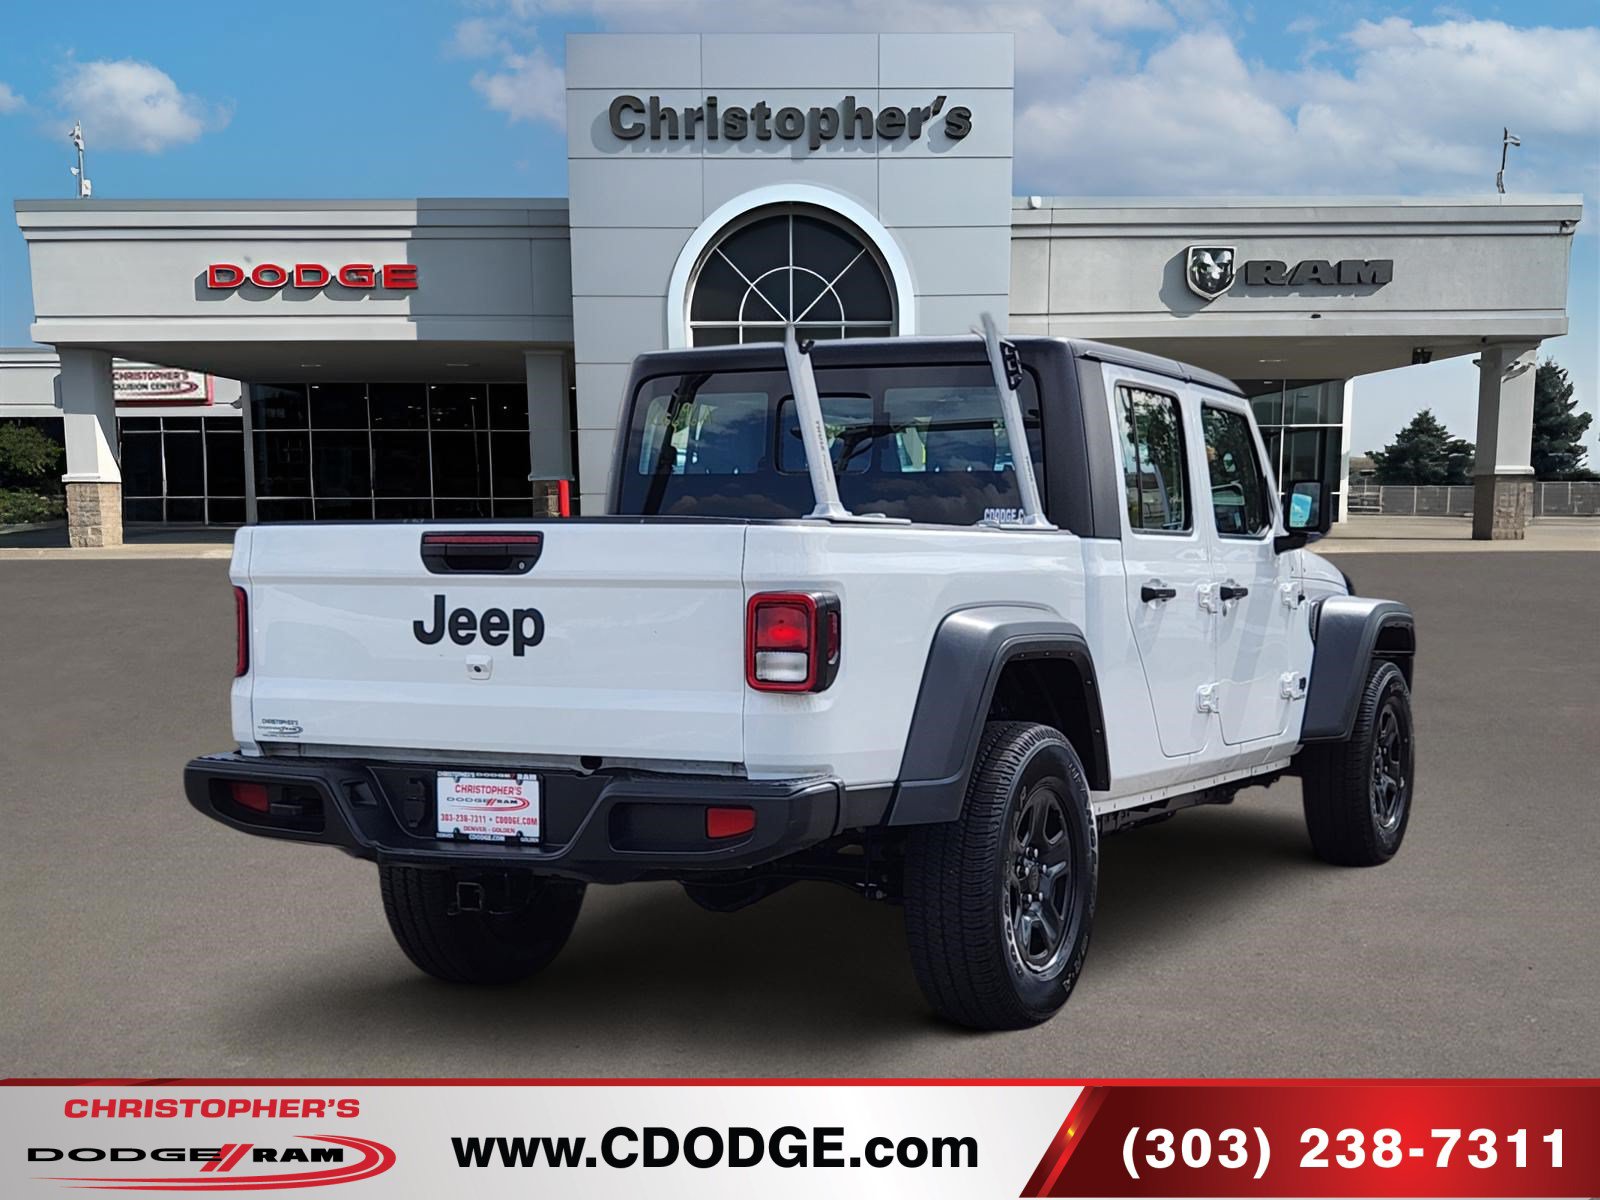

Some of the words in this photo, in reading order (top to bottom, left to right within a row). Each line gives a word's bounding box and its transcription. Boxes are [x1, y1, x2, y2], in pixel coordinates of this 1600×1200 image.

[608, 94, 973, 151] Christopher's
[207, 263, 418, 289] DODGE
[1246, 259, 1394, 286] RAM
[150, 382, 181, 391] CENTER
[413, 594, 545, 657] Jeep
[455, 784, 523, 795] CHRISTOPHER'S
[440, 813, 487, 824] 303-238-7311
